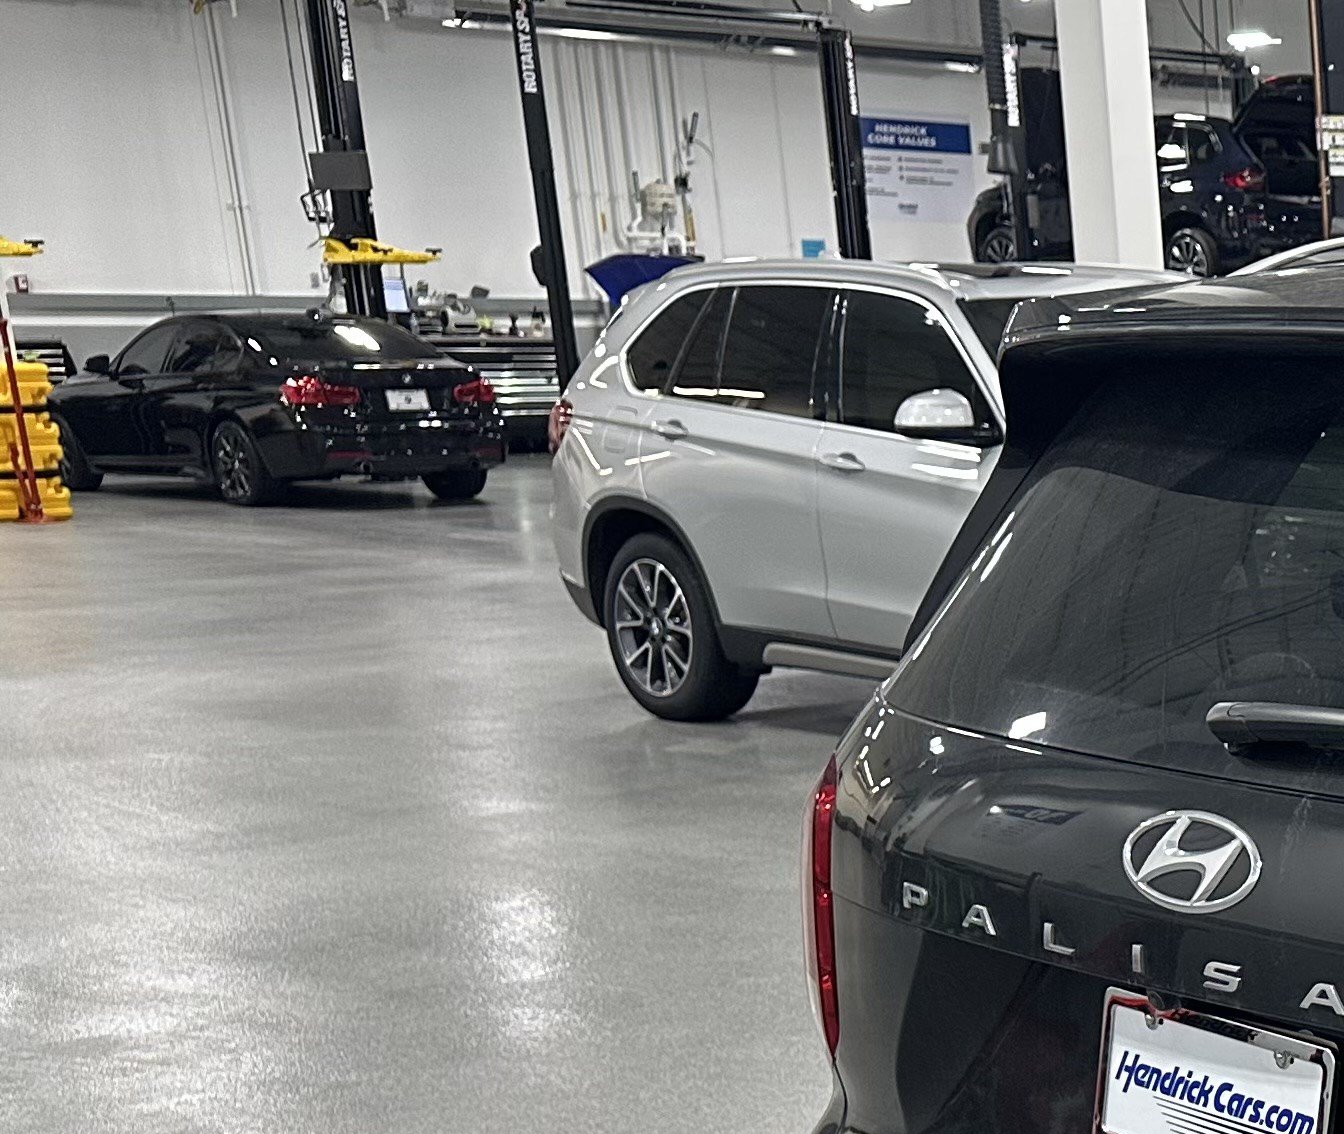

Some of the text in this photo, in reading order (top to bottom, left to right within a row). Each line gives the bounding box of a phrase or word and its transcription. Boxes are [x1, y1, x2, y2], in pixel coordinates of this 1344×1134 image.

[517, 32, 538, 93] ROTARY
[874, 122, 928, 136] HENDRICK
[866, 132, 937, 147] CORE VALUES
